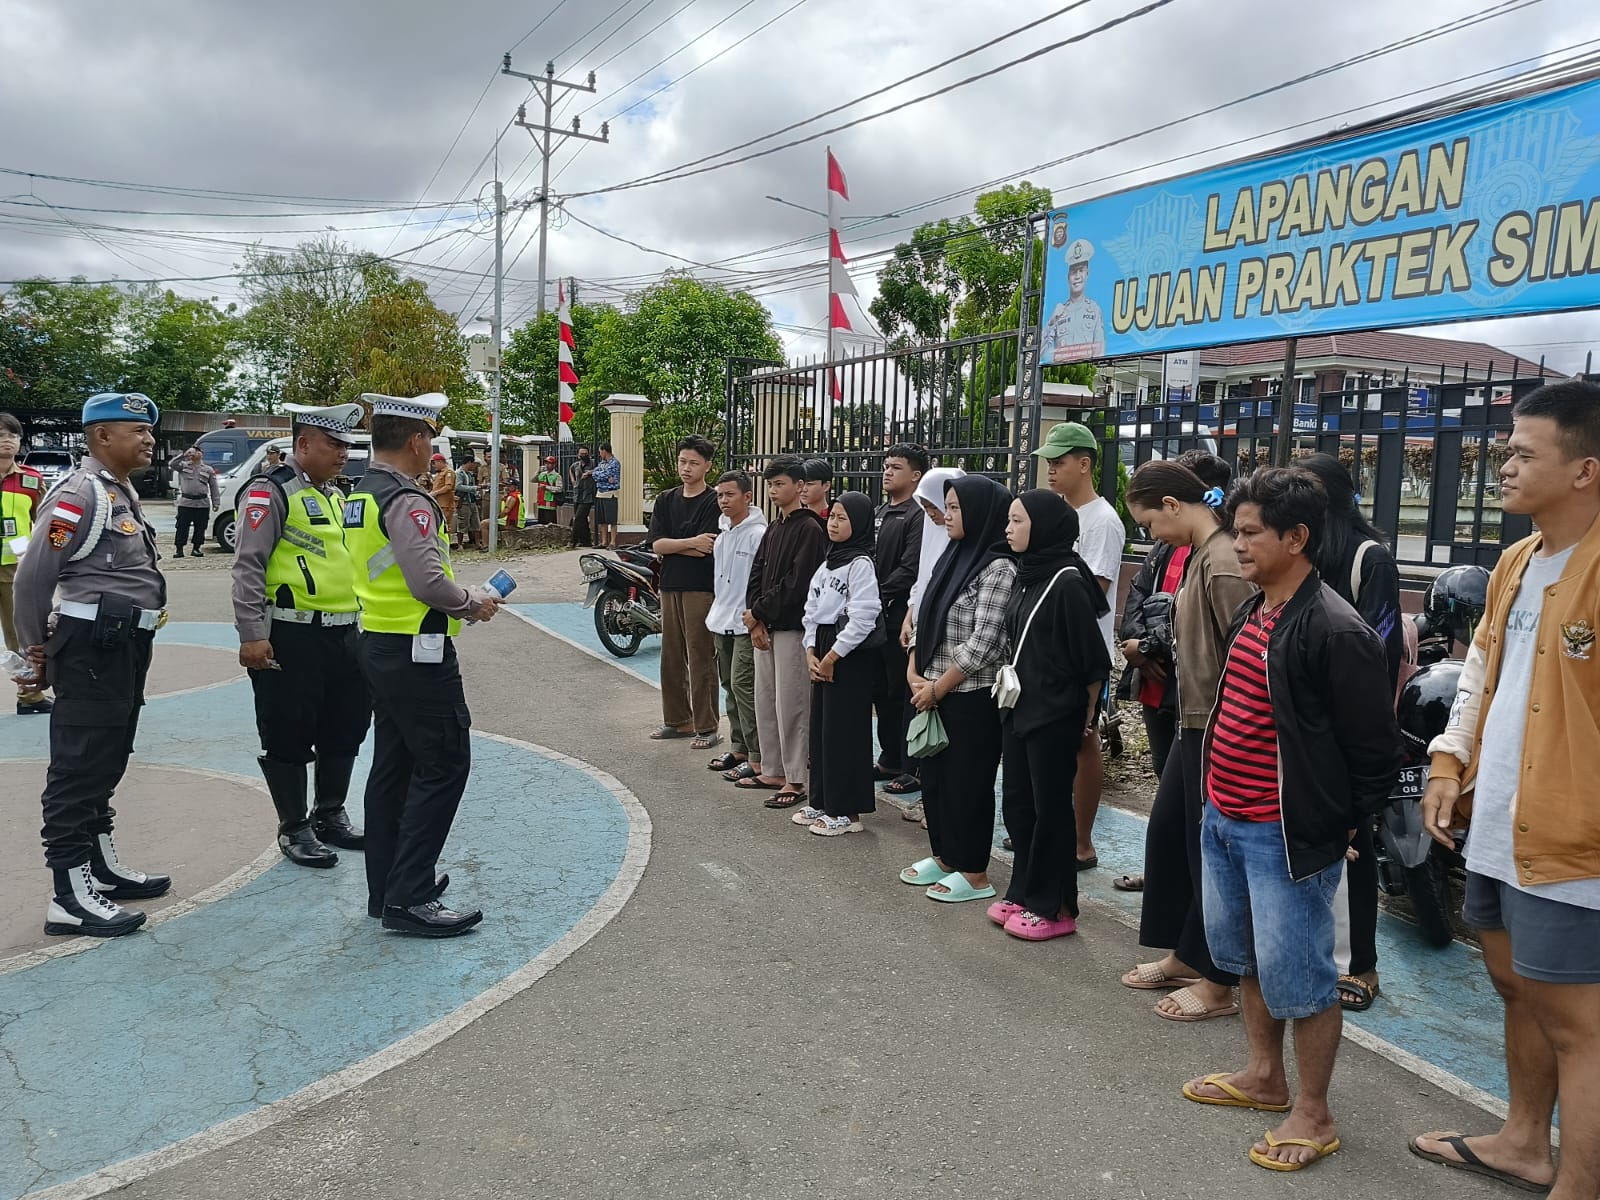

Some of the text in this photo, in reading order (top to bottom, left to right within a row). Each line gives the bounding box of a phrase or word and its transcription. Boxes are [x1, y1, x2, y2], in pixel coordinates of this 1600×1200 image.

[1203, 136, 1470, 253] LAPANGAN
[1112, 195, 1600, 334] UJIAN PRAKTEK SIM
[1293, 417, 1329, 432] Bankig
